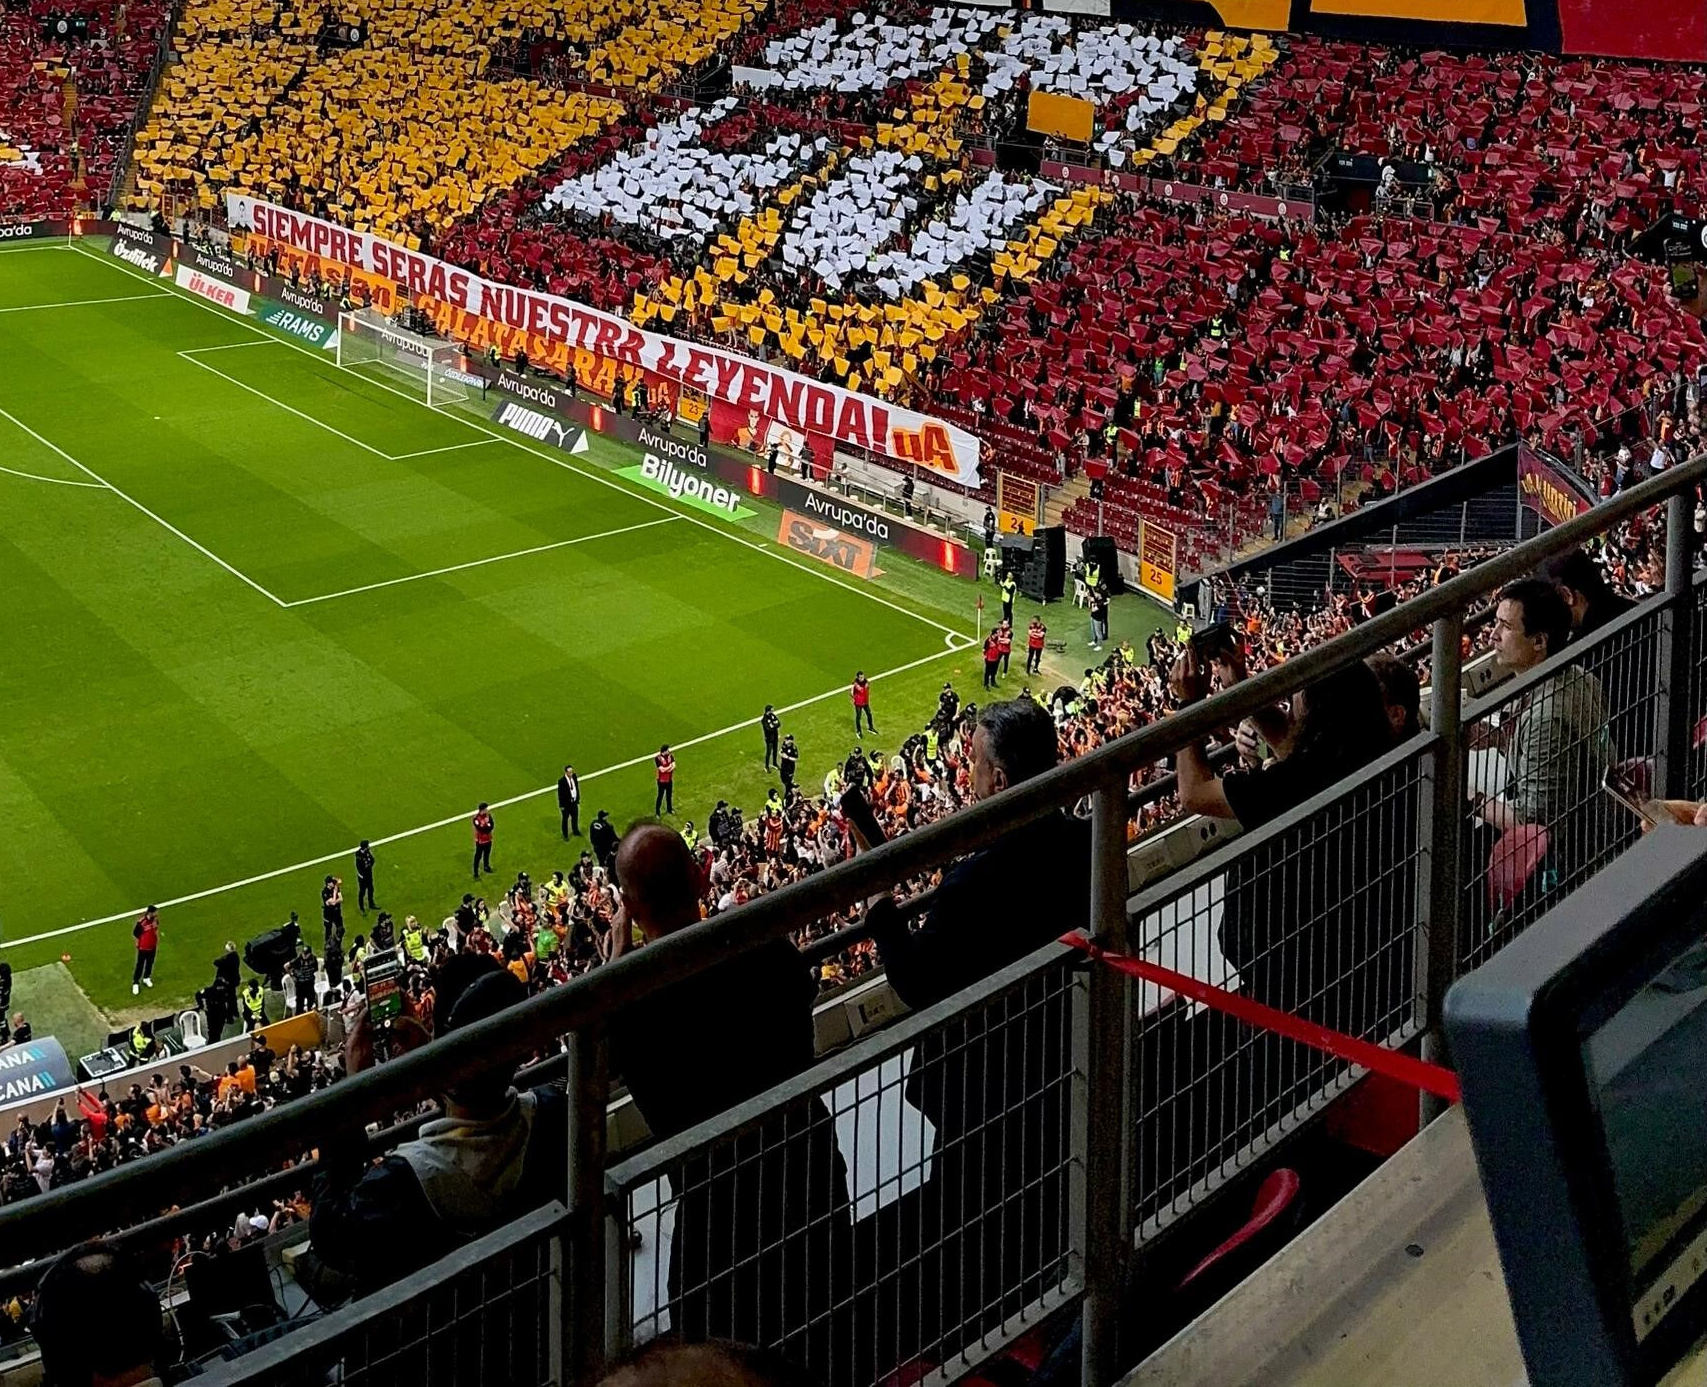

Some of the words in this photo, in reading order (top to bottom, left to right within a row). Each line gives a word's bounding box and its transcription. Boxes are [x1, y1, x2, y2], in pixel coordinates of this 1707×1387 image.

[117, 224, 154, 245] Avrupa'da
[113, 242, 158, 273] Özdilek
[196, 254, 233, 277] Avrupa'da
[188, 272, 235, 307] ÜLKER
[281, 288, 323, 314] Avrupa'da
[253, 204, 364, 269] SIEMPRE
[480, 284, 645, 366] NUESTRA
[656, 341, 889, 453] LEYENDA!
[277, 309, 325, 342] RAMS
[416, 292, 645, 401] GALATASARAY
[498, 374, 556, 408] Avrupa'da
[498, 402, 552, 440] PUMA
[688, 403, 699, 414] 23
[638, 430, 707, 468] Avrupa'da
[641, 453, 741, 512] Bilyoner
[804, 492, 889, 540] Avrupa'da
[1150, 569, 1163, 585] 25
